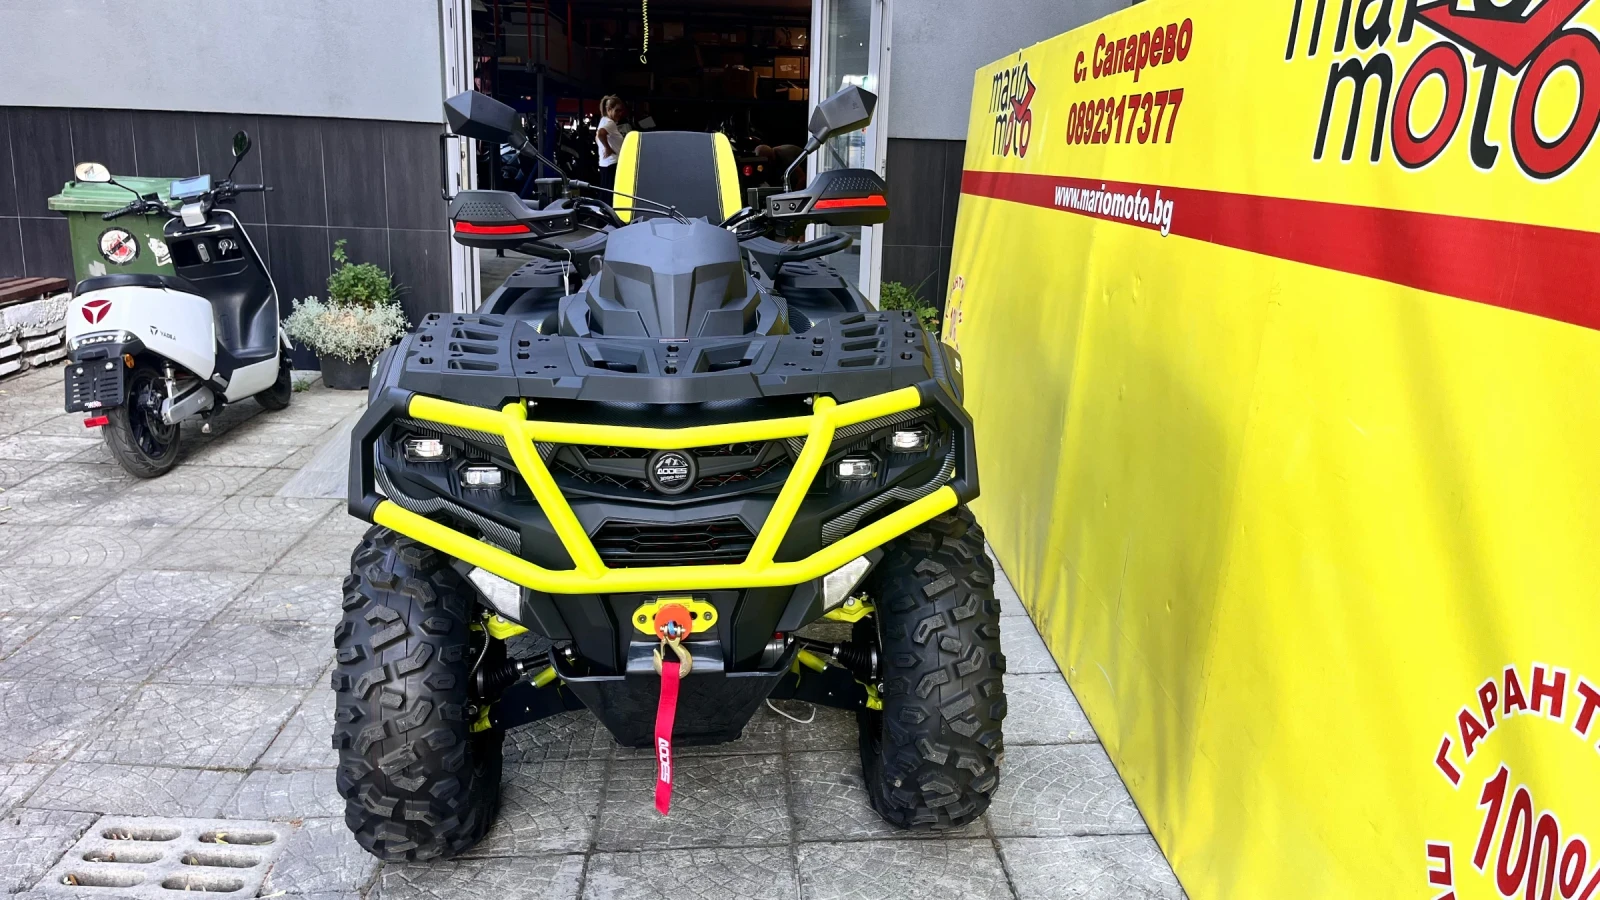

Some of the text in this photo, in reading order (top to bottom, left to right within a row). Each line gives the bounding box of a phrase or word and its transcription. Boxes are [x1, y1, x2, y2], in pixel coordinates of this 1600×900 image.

[1092, 17, 1193, 83] Сапарево
[988, 51, 1028, 114] mario
[1312, 28, 1600, 180] moto
[992, 108, 1032, 158] moto
[1066, 87, 1185, 145] 0892317377
[1054, 183, 1175, 238] www.mariomoto.bg
[1435, 666, 1600, 786] ГАРАНТ
